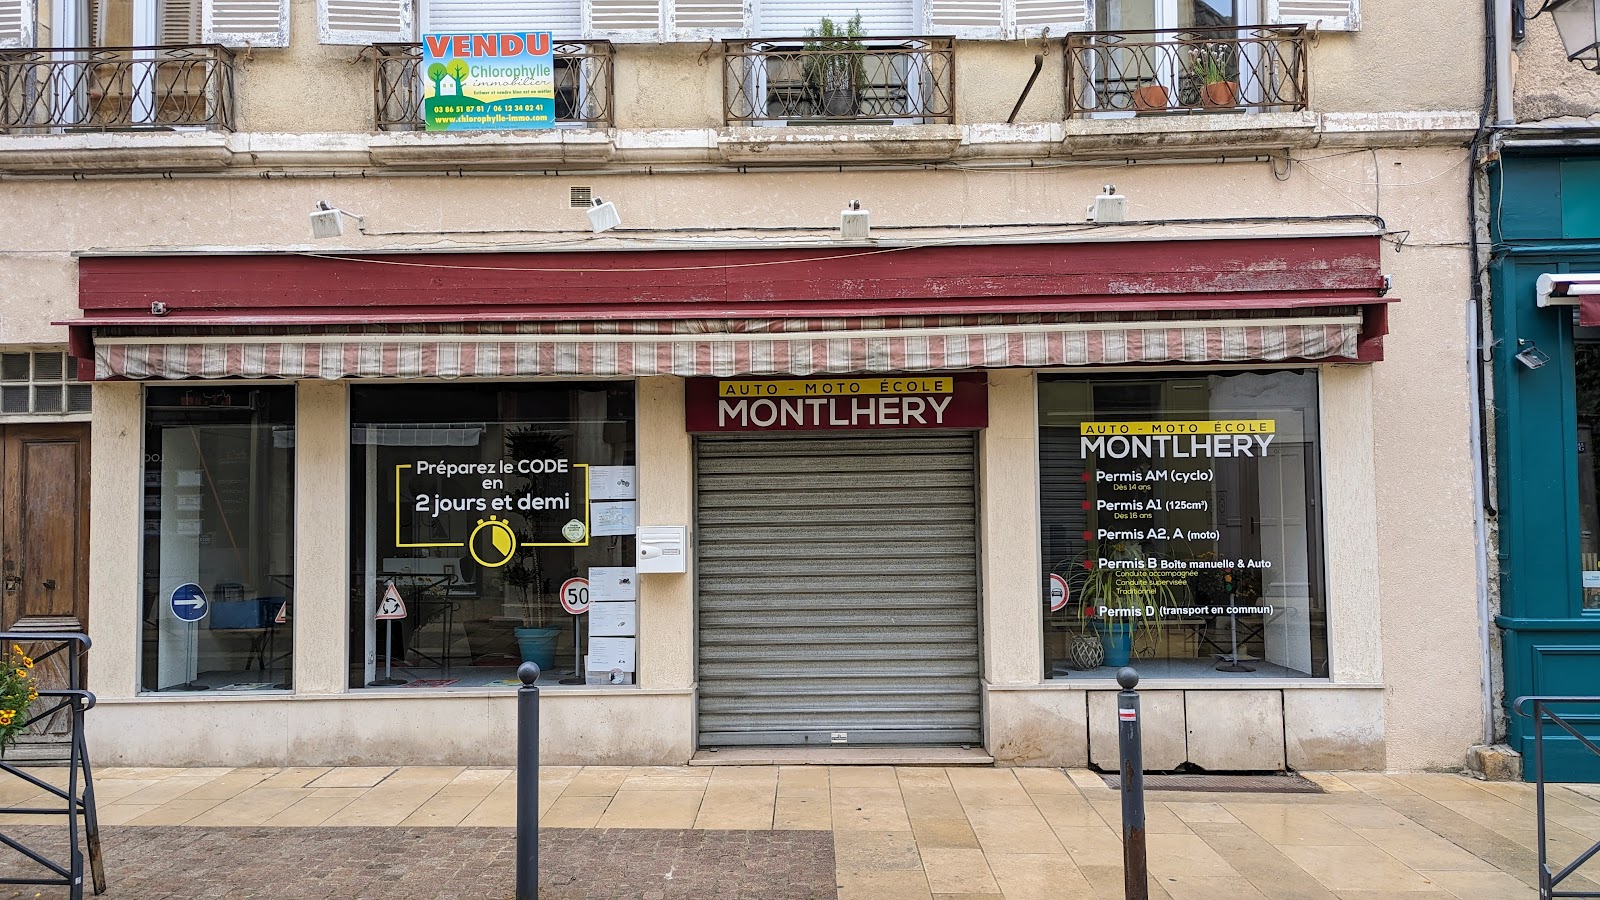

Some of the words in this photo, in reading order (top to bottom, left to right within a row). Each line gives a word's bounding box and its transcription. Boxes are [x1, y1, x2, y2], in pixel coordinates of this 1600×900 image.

[425, 33, 551, 58] VENDU
[471, 64, 551, 80] Chlorophylle
[473, 77, 551, 87] immobilier
[486, 105, 492, 113] /
[435, 114, 548, 124] www.chlorophylle-immo.com
[725, 384, 778, 395] AUTO
[805, 382, 861, 394] MOTO
[880, 379, 943, 393] ÉCOLE
[718, 396, 953, 427] MONTLHERY
[1085, 424, 1130, 434] AUTO
[1152, 424, 1198, 433] MOTO
[1214, 421, 1267, 432] ÉCOLE
[1080, 434, 1275, 459] MONTLHERY
[416, 460, 496, 477] Préparez
[499, 460, 514, 474] le
[517, 459, 569, 473] CODE
[1096, 470, 1142, 482] Permis
[1145, 470, 1168, 481] AM
[1171, 469, 1214, 483] (cyclo)
[482, 479, 503, 489] en
[1113, 483, 1127, 491] Dès
[415, 494, 430, 512] 2
[431, 493, 487, 518] jours
[491, 496, 513, 511] et
[517, 492, 570, 510] demi
[1096, 499, 1143, 511] Permis
[1145, 499, 1162, 510] A1
[1097, 528, 1144, 540] Permis
[1146, 528, 1170, 541] A2,
[1172, 528, 1184, 539] A
[1187, 530, 1220, 541] (moto)
[1098, 557, 1145, 569] Permis
[1147, 557, 1157, 568] B
[1160, 559, 1187, 569] Boîte
[1189, 559, 1235, 568] manuelle
[1237, 559, 1245, 568] &
[1247, 559, 1272, 568] Auto
[1148, 570, 1199, 578] accompagnée
[1149, 579, 1187, 587] supervisée
[568, 587, 589, 605] 50
[1116, 587, 1157, 595] Traditionnel
[1099, 606, 1142, 617] Permis
[1145, 606, 1155, 616] D
[1159, 606, 1209, 617] (transport
[1226, 605, 1274, 615] commun)
